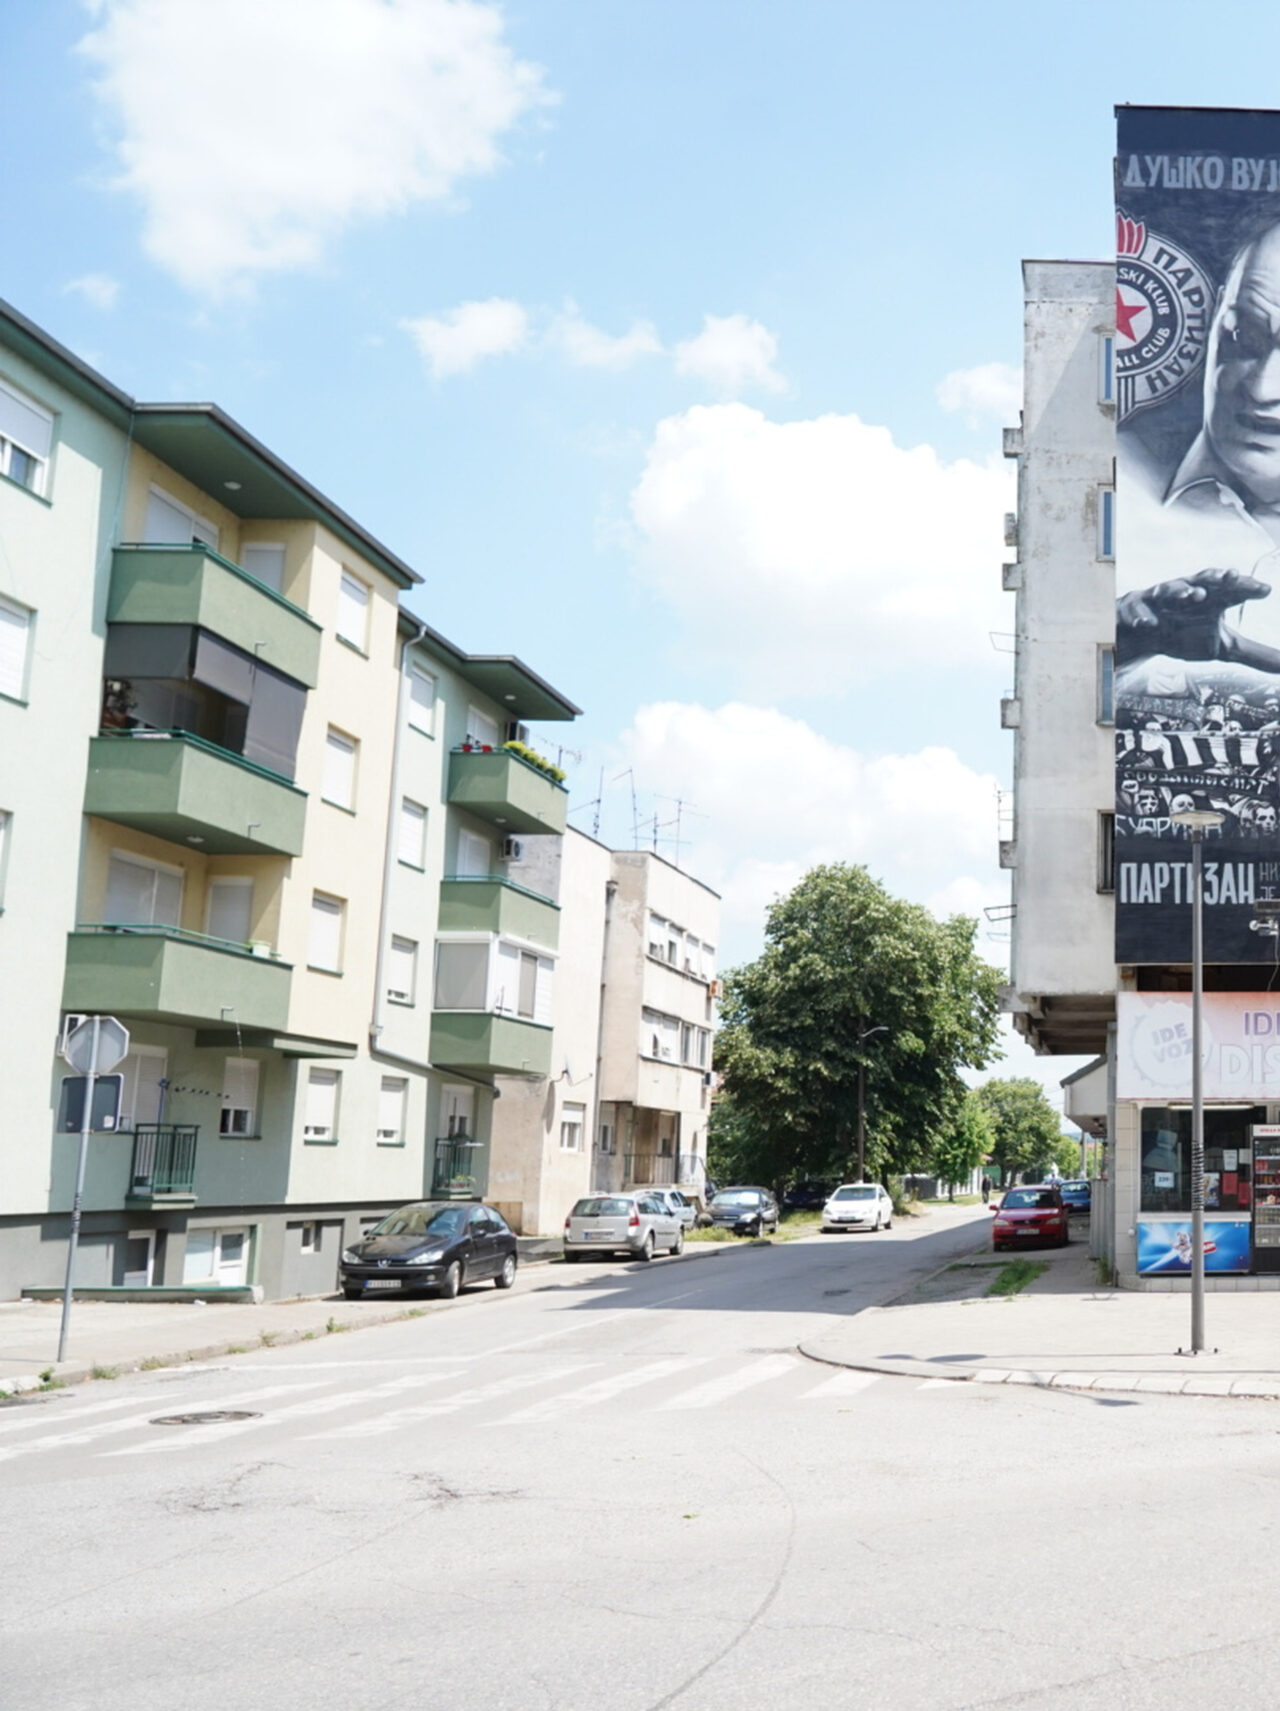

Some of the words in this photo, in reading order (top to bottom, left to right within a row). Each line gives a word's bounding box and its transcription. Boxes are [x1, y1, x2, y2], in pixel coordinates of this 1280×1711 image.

[1122, 153, 1225, 190] ДУШКО
[1117, 267, 1146, 285] SKI
[1143, 279, 1170, 315] KLUB
[1145, 247, 1206, 394] ПАРТИЗАН
[1141, 327, 1171, 358] CLUB
[1152, 1022, 1188, 1046] IDE
